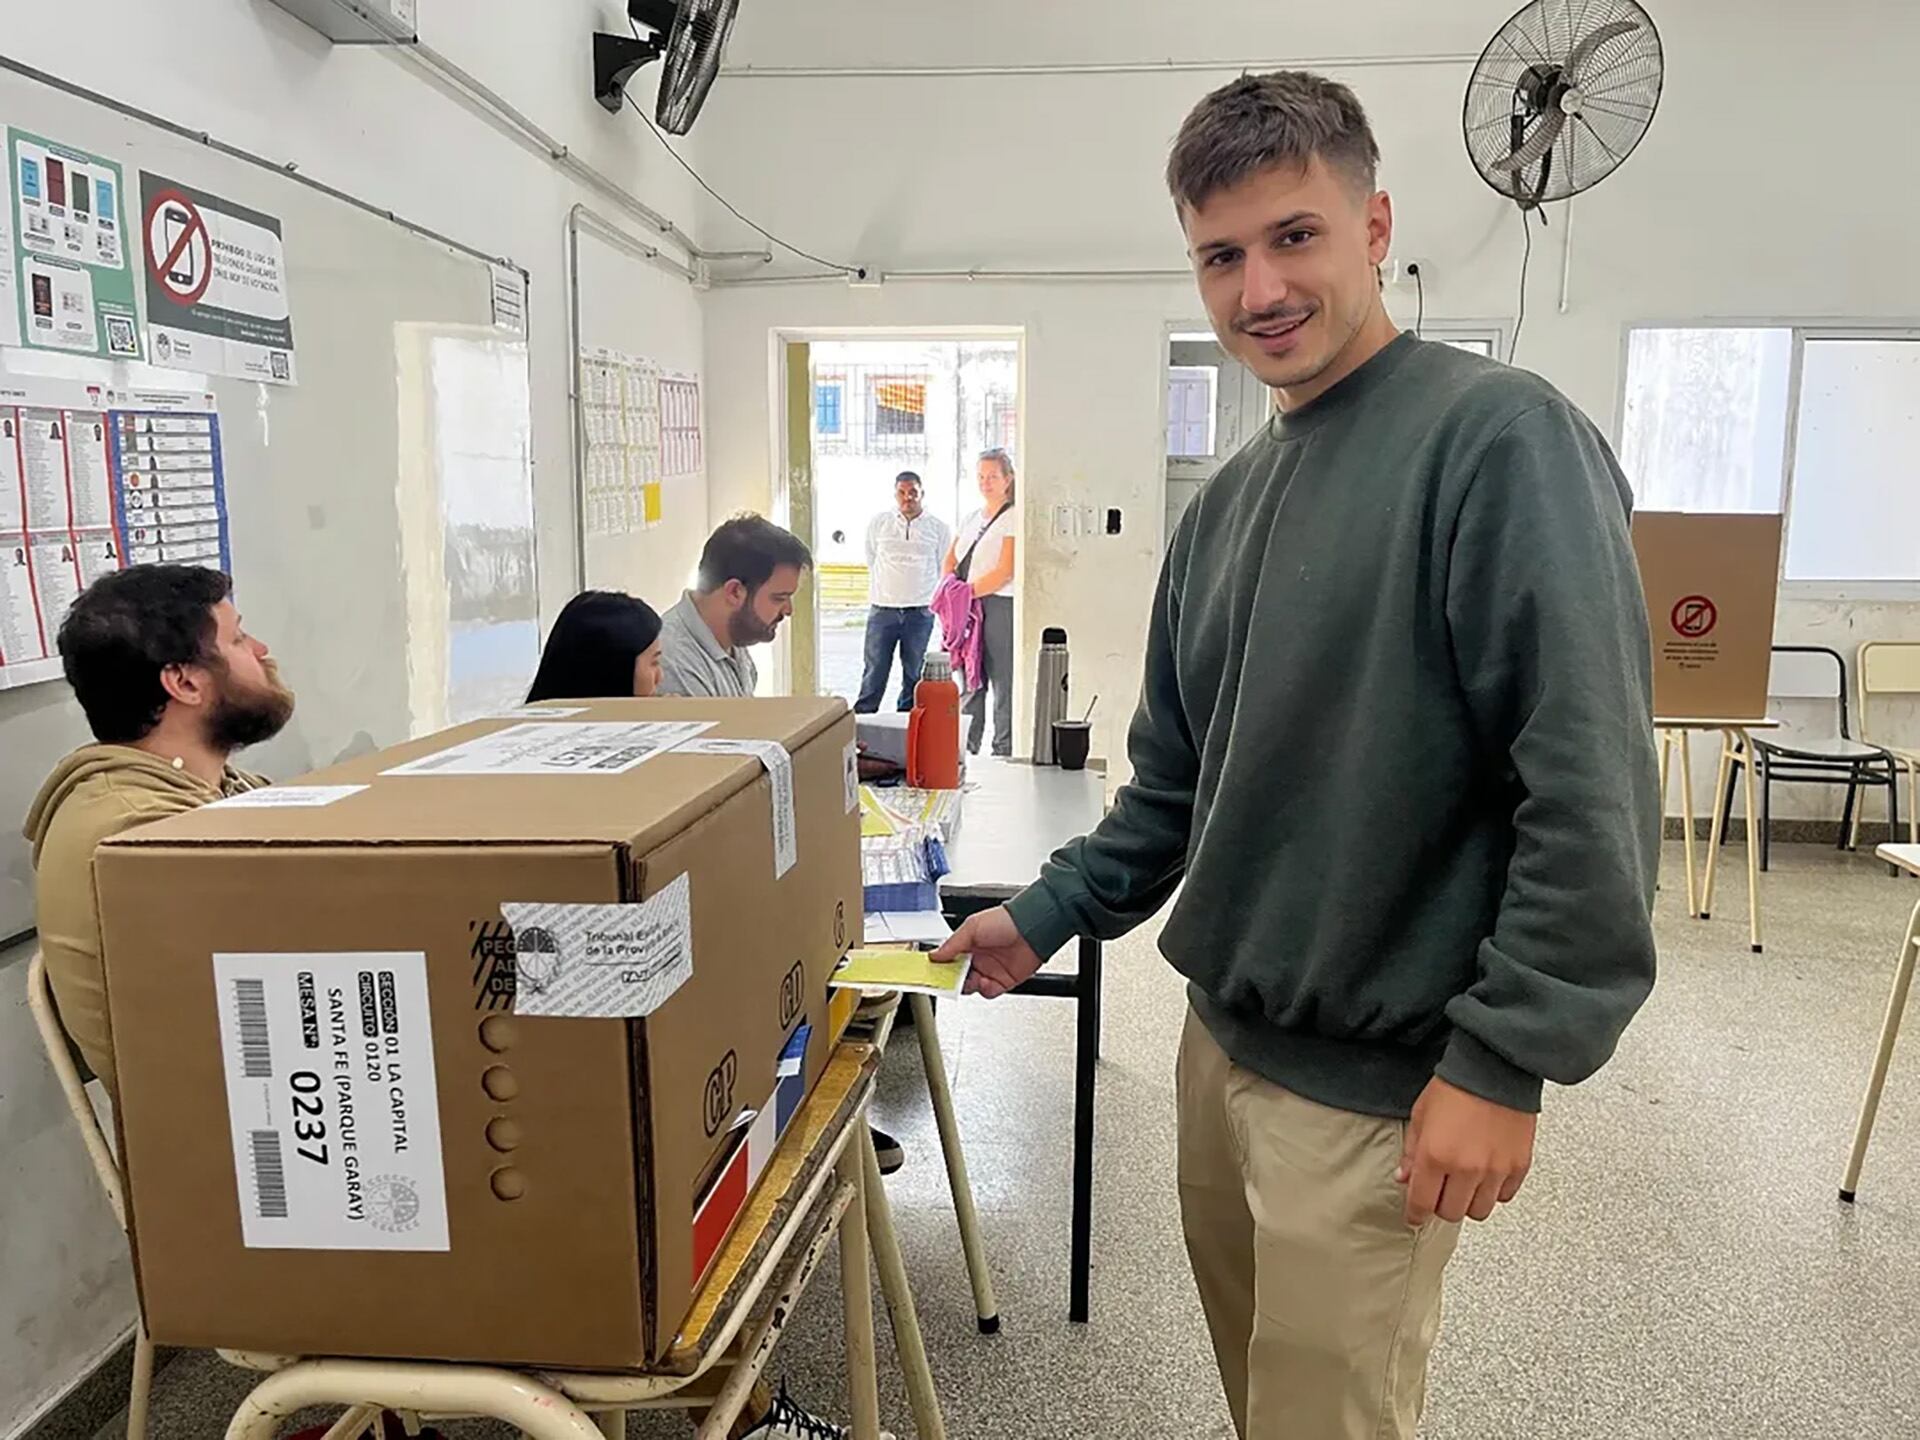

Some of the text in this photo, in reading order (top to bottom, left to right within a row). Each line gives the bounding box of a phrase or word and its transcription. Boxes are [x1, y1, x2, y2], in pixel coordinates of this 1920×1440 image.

[585, 931, 633, 942] Tribunal
[298, 974, 316, 1018] MESA
[365, 1043, 381, 1081] 0120
[384, 1037, 399, 1055] 01
[387, 1064, 402, 1083] LA
[704, 1049, 737, 1139] CP
[290, 1071, 329, 1165] 0237
[328, 988, 365, 1220] SANTA FE (PARQUE GARAY)
[390, 1087, 408, 1153] CAPITAL
